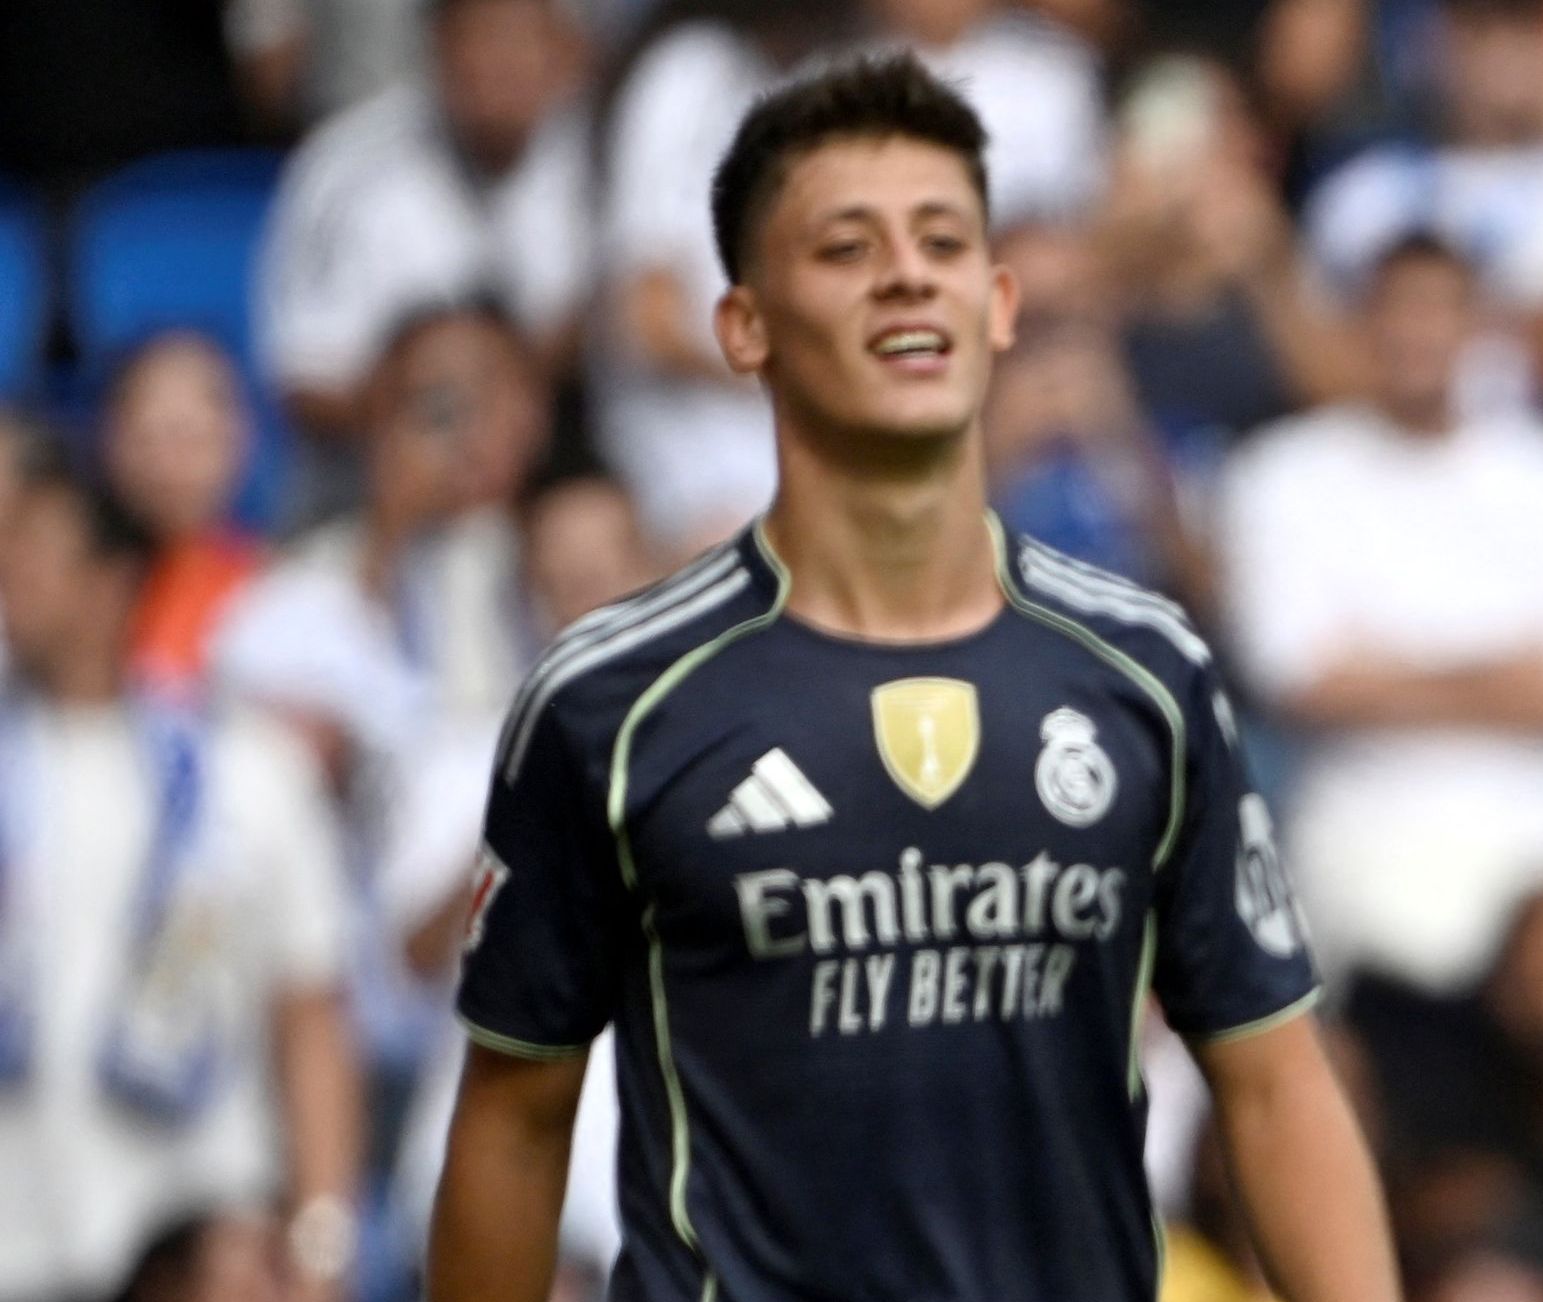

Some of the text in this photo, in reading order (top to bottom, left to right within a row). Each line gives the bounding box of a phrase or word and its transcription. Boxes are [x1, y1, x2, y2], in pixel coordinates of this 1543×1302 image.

[733, 846, 1127, 960] Emirates
[809, 943, 1077, 1039] FLY BETTER
